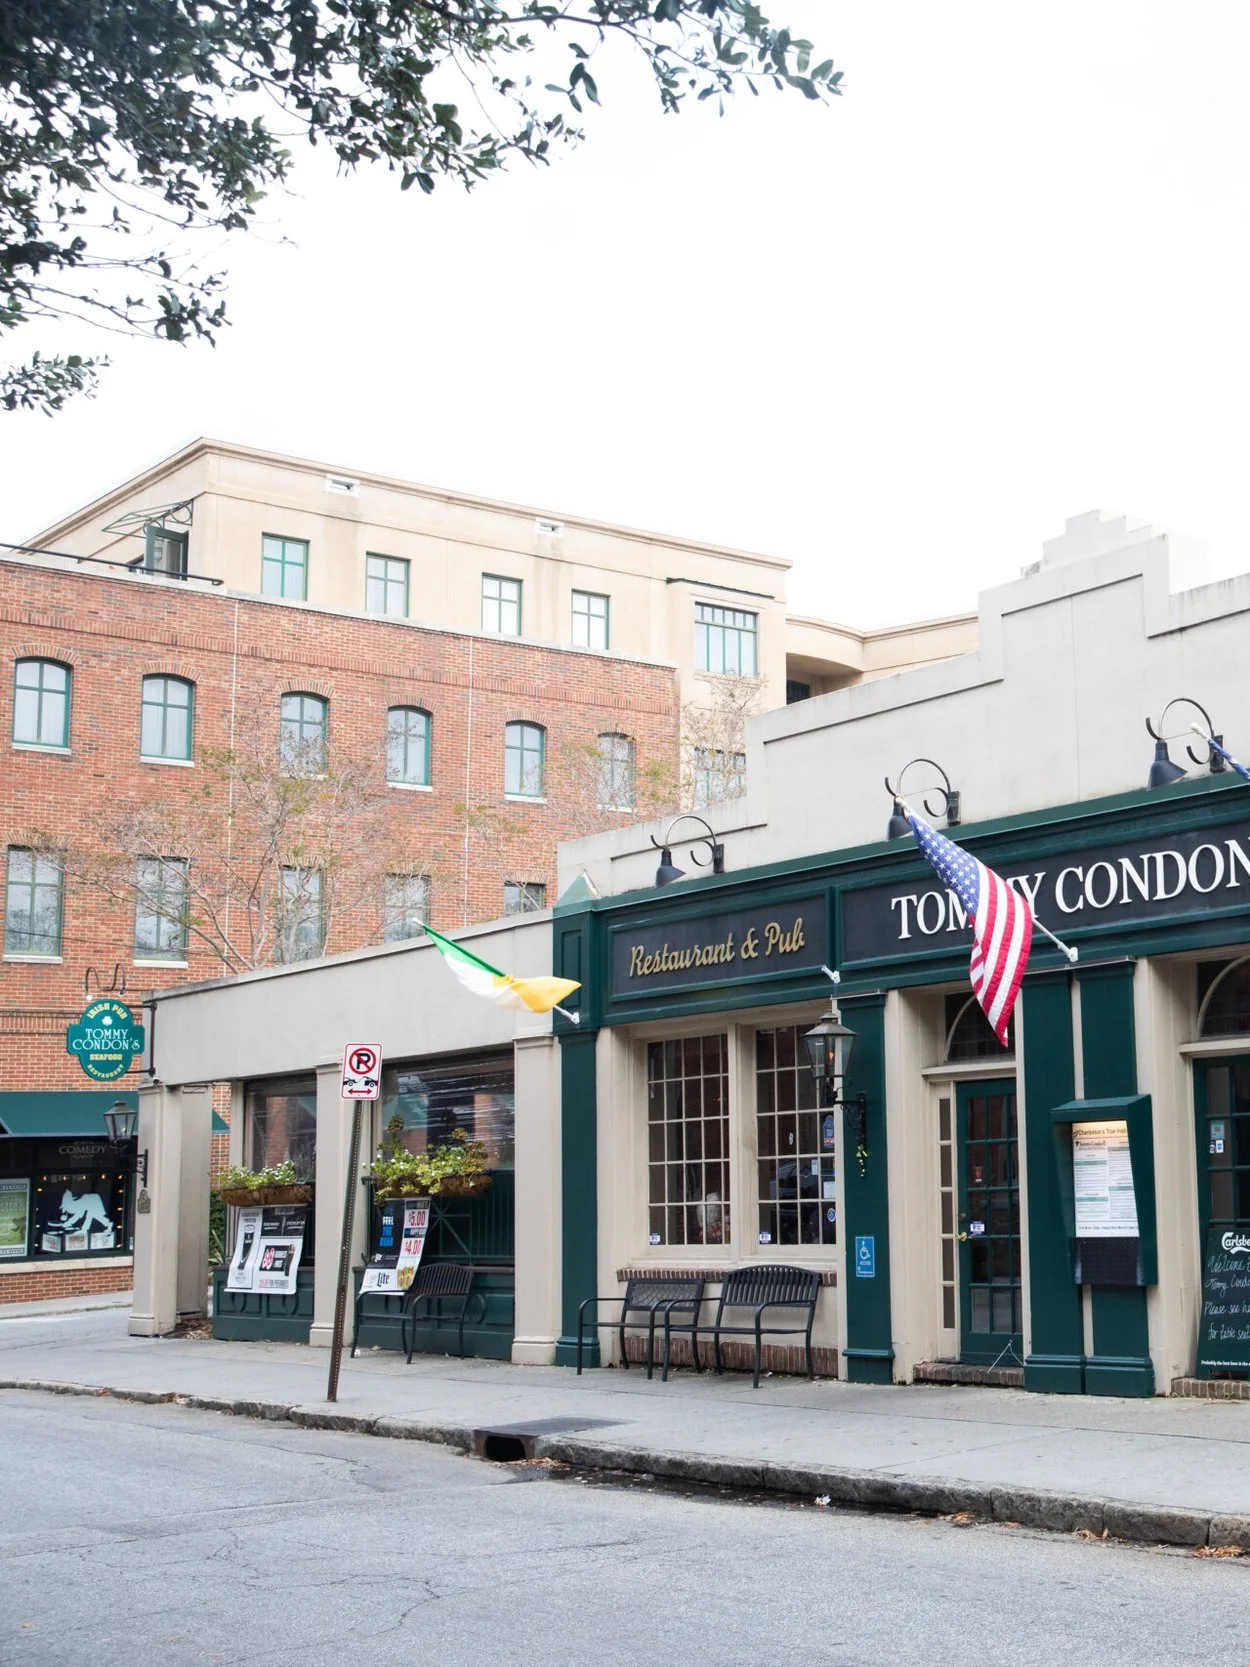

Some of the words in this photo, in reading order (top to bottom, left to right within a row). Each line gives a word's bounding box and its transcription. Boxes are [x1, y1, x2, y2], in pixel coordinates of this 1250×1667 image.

[891, 872, 1046, 940] TOMY
[629, 932, 735, 977] Restaurant
[741, 928, 759, 960] &
[765, 917, 806, 956] Pub
[87, 1003, 110, 1019] IRISH
[112, 1004, 128, 1020] PUB
[86, 1028, 128, 1040] TOMMY
[72, 1037, 140, 1050] CONDON'S
[90, 1053, 122, 1061] SEAFOOD
[356, 1053, 371, 1069] P
[87, 1063, 124, 1078] RESTAURANT
[58, 1144, 108, 1154] COMEDY
[408, 1210, 426, 1227] $5.00
